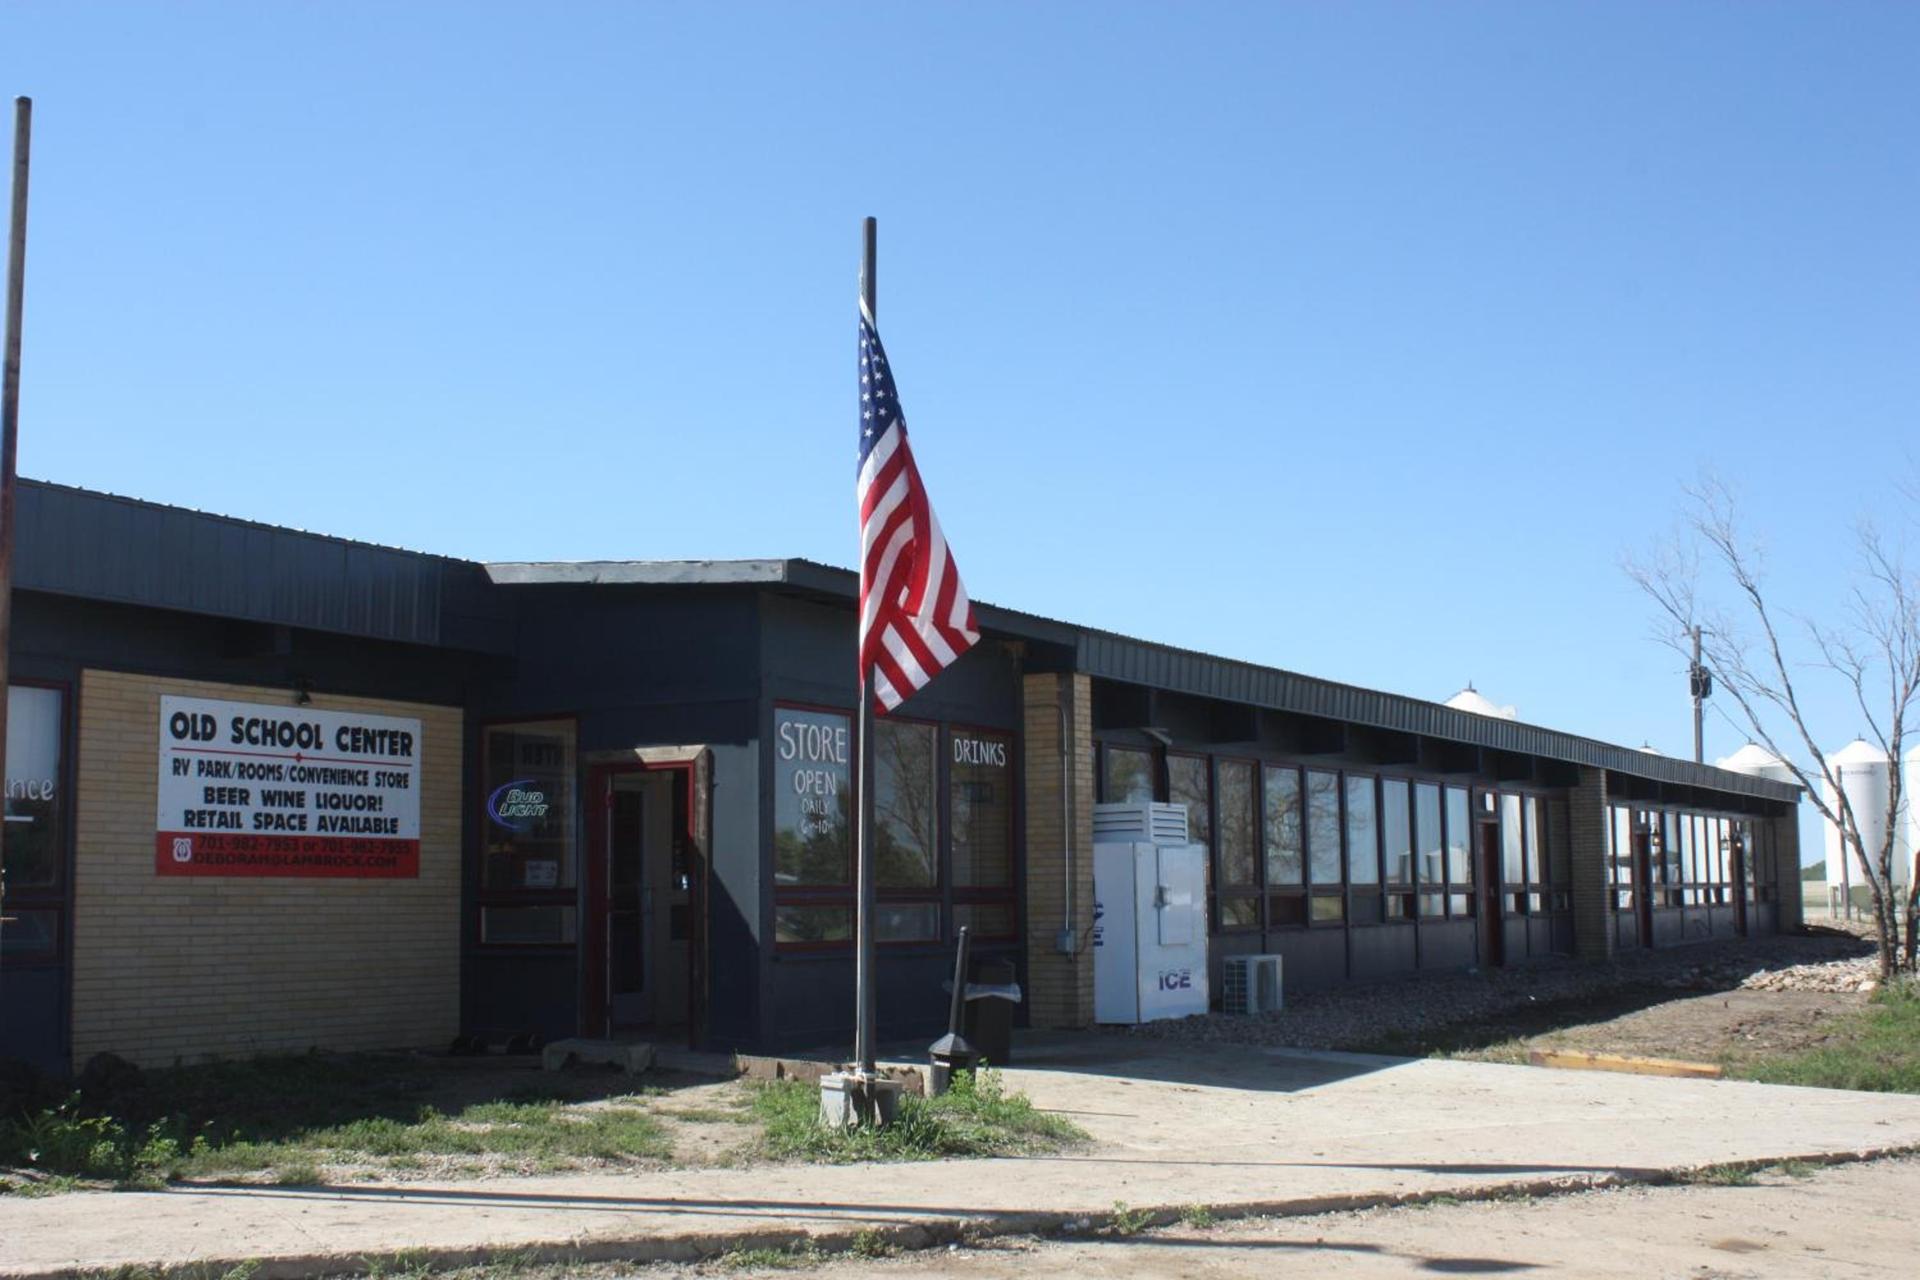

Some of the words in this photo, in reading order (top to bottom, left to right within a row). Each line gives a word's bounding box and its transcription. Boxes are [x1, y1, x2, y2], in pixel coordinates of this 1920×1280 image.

[170, 712, 217, 741] OLD
[231, 717, 323, 750] SCHOOL
[336, 726, 413, 757] CENTER
[779, 721, 847, 763] STORE
[953, 738, 1006, 767] DRINKS
[172, 758, 191, 776] RV
[197, 759, 369, 787] PARK/ROOMS/CONVENIENCE
[375, 770, 410, 789] STORE
[794, 770, 836, 796] OPEN
[204, 787, 250, 806] BEER
[261, 789, 306, 808] WINE
[316, 792, 383, 811] LIQUOR!
[801, 798, 830, 816] DAILY
[184, 809, 243, 829] RETAIL
[253, 812, 307, 831] SPACE
[317, 815, 399, 834] AVAILABLE
[1158, 968, 1192, 991] ICE
